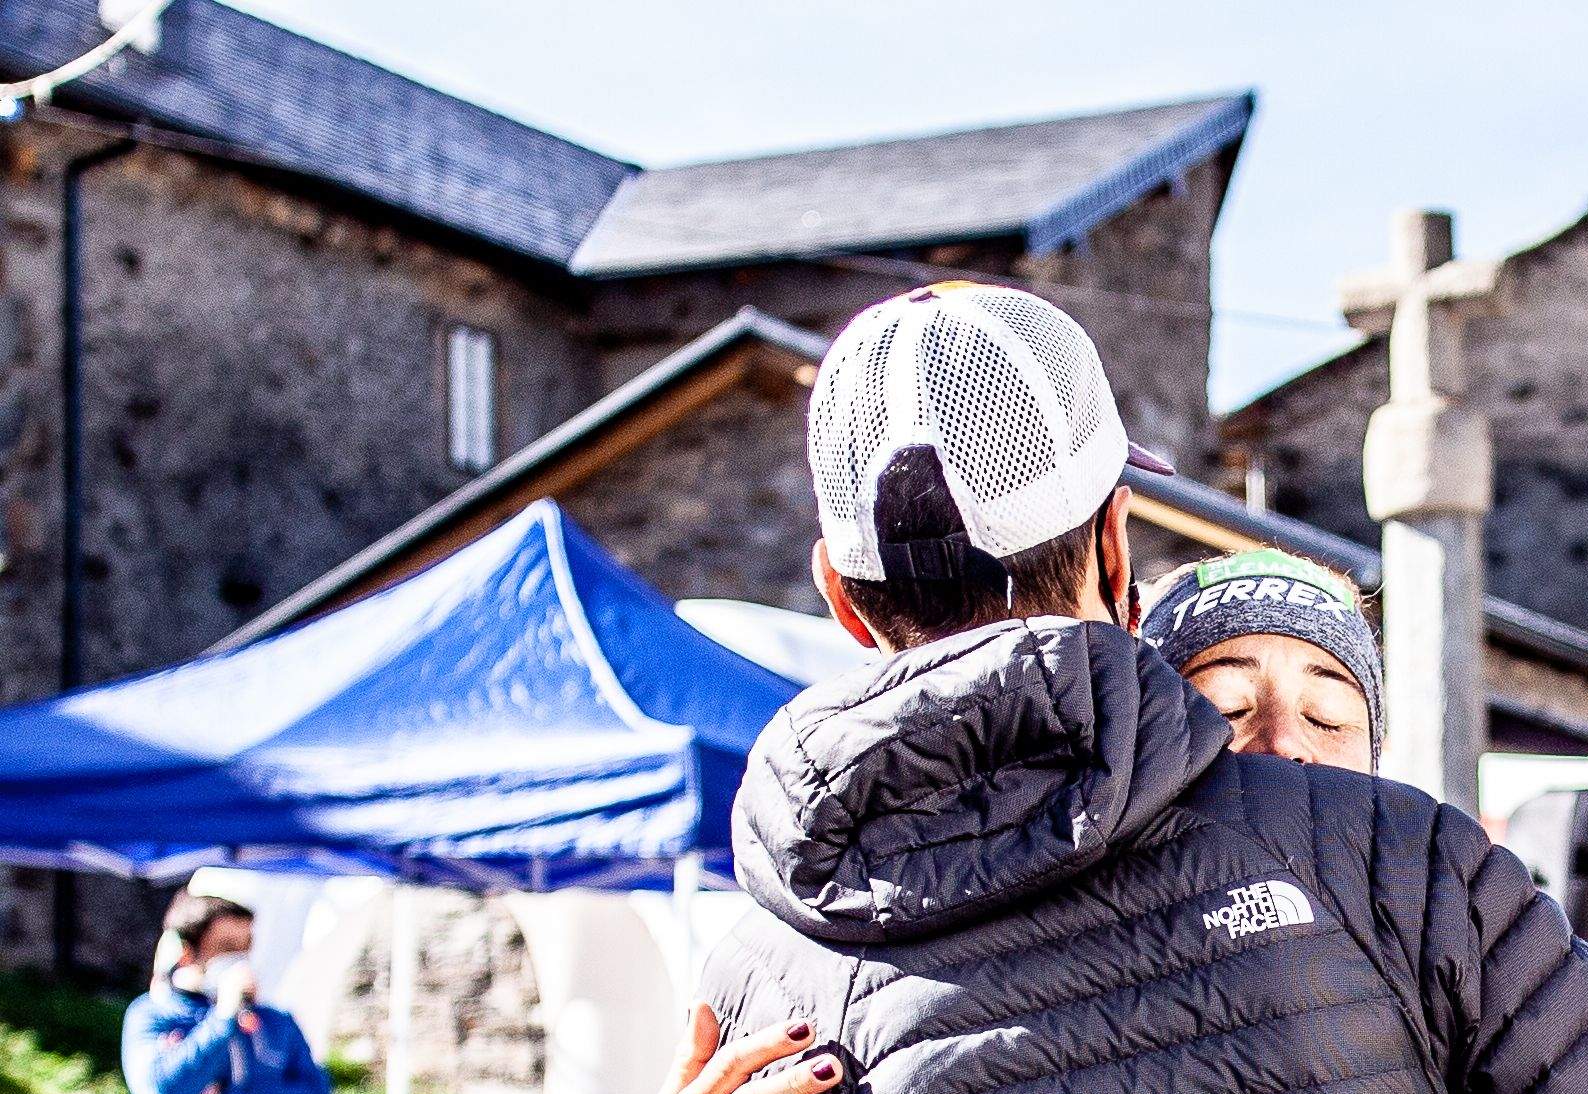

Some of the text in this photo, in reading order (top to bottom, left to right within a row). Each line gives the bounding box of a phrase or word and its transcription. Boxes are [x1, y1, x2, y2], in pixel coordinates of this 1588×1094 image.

[1173, 577, 1346, 631] TERREX
[1227, 882, 1267, 904] THE
[1202, 900, 1278, 930] NORTH
[1227, 912, 1280, 940] FACE
